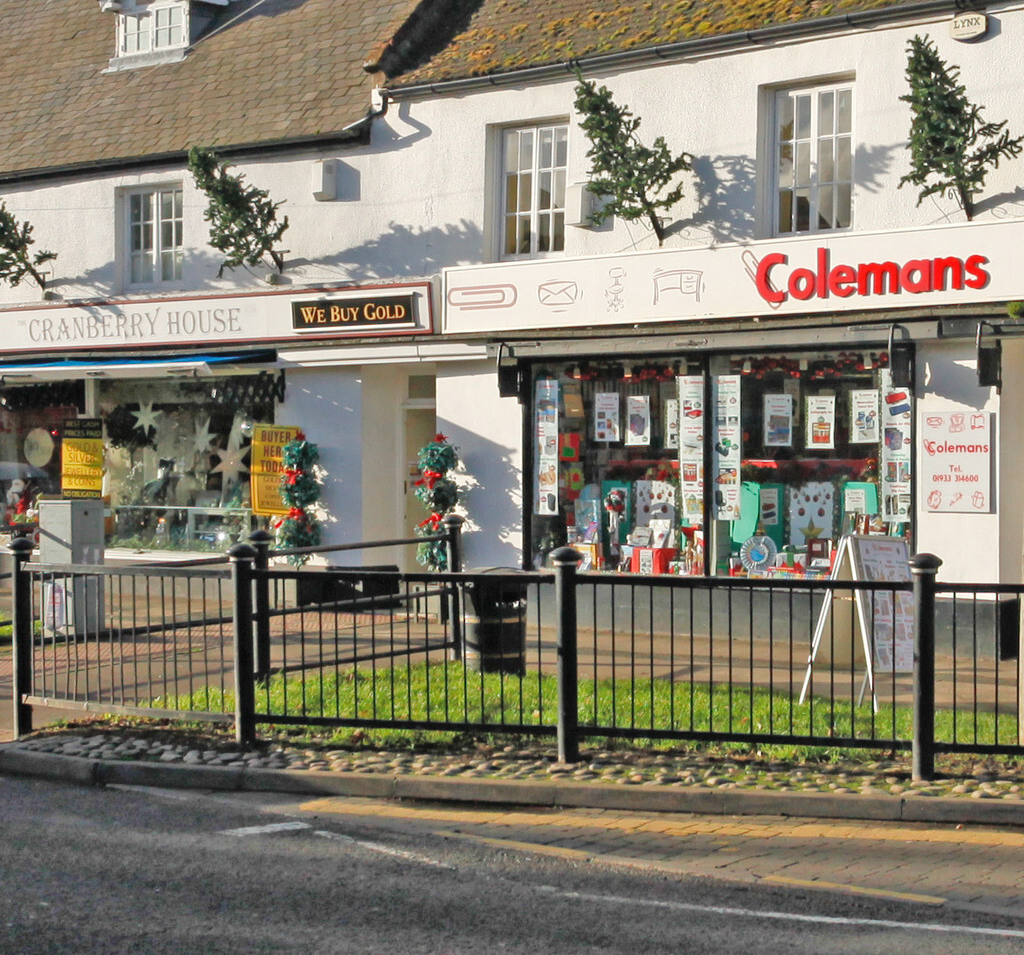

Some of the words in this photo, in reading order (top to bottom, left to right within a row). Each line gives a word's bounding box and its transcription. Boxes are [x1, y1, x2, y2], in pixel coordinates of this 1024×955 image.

[954, 17, 980, 29] LYNX
[756, 247, 989, 303] Colemans
[300, 306, 326, 323] WE
[330, 306, 359, 322] BUY
[363, 303, 405, 320] GOLD
[28, 307, 162, 343] CRANBERRY
[167, 308, 242, 335] HOUSE
[261, 430, 292, 443] BUYER
[263, 446, 283, 458] HER
[927, 440, 988, 454] Colemans
[260, 460, 286, 473] TODA
